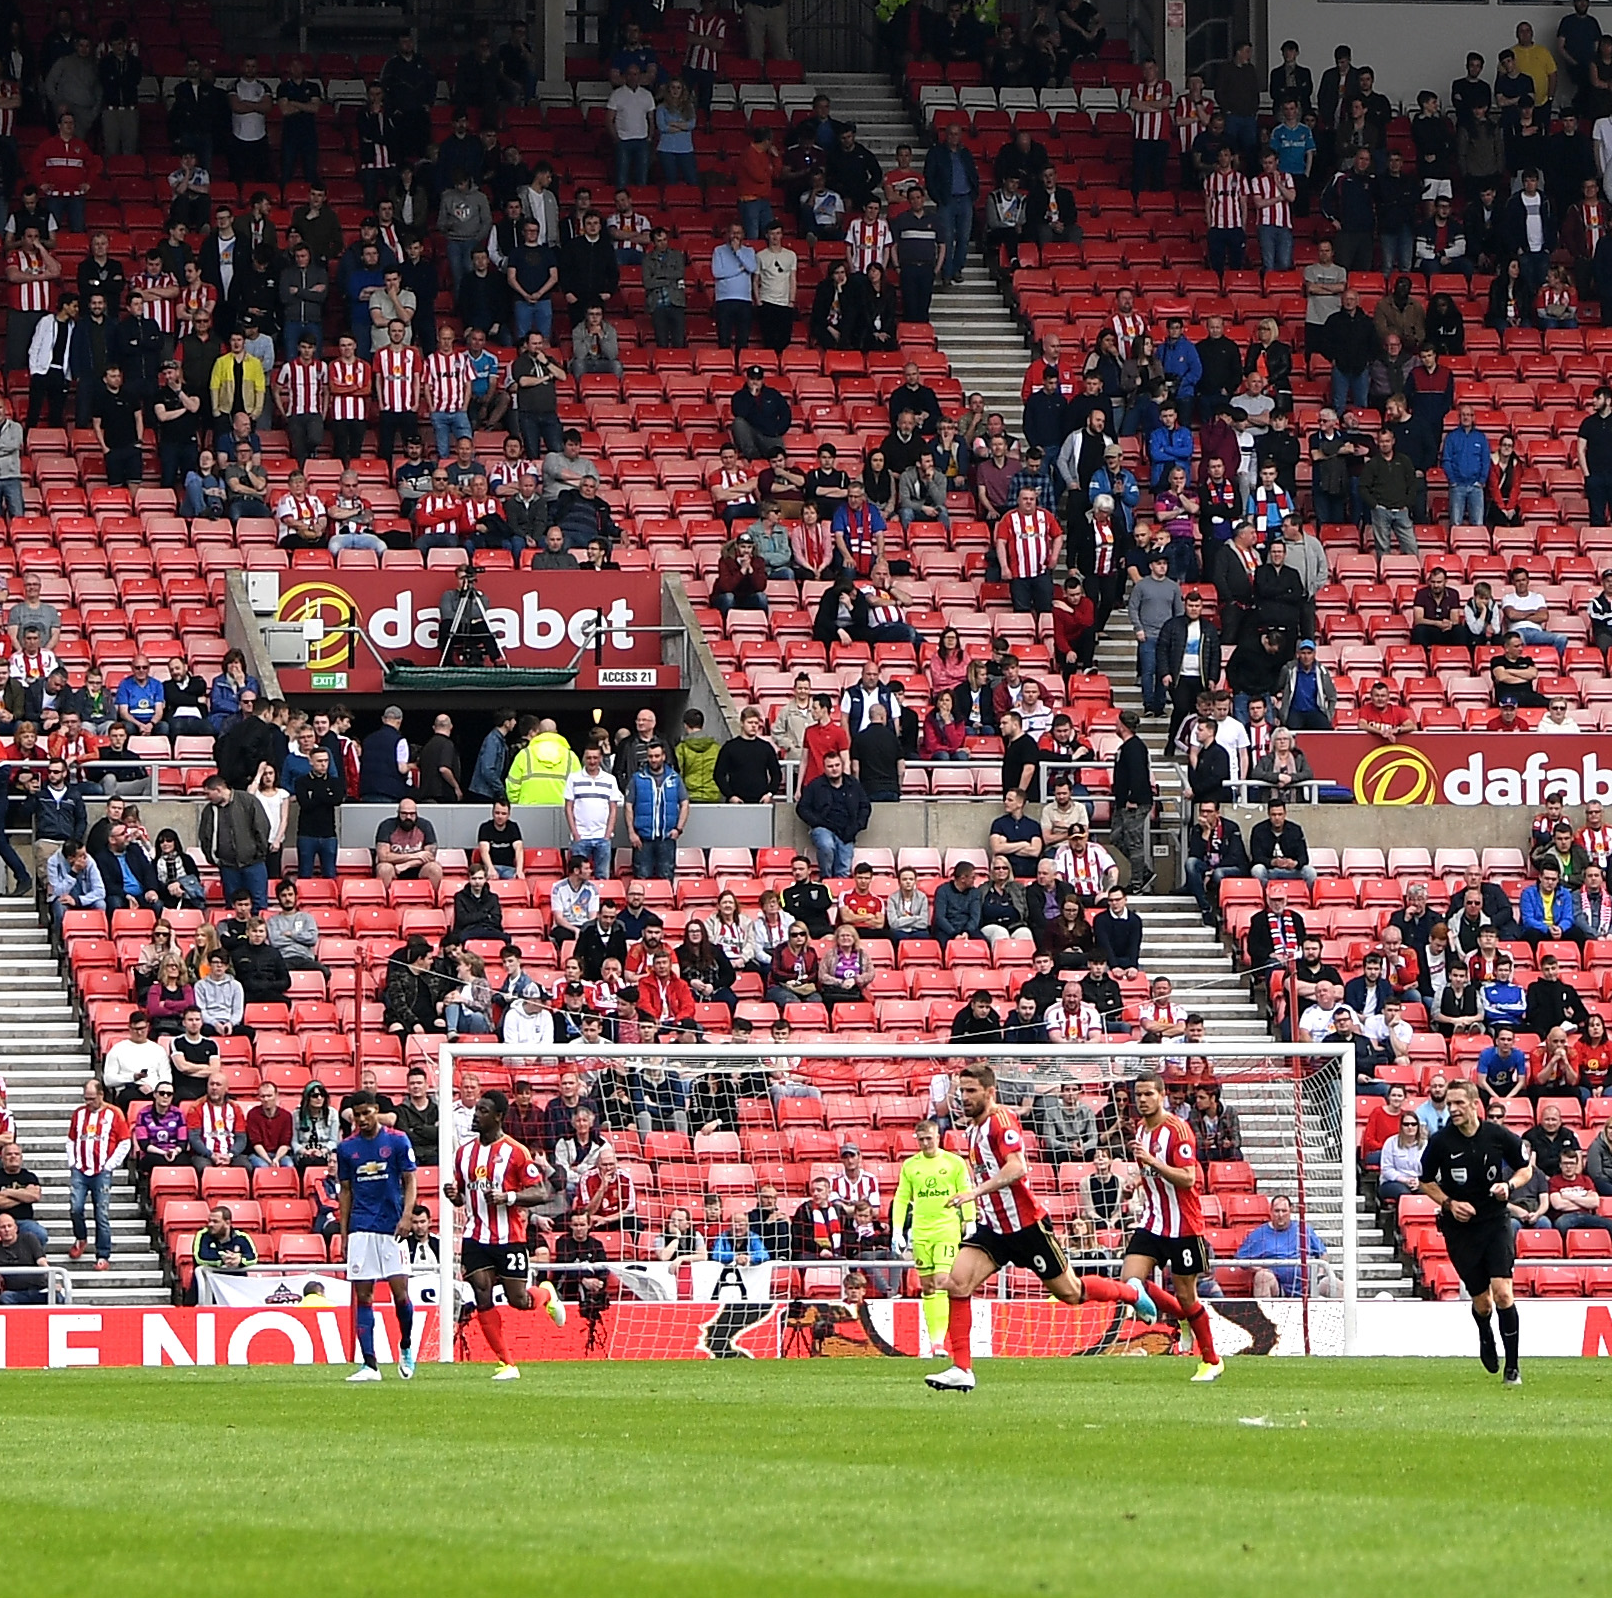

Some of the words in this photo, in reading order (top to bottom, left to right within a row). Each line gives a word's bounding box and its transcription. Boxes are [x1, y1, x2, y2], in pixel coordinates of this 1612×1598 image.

[368, 590, 634, 650] daabet
[313, 676, 334, 687] EXIT
[602, 672, 637, 684] ACCESS
[641, 672, 652, 683] 21
[917, 1188, 950, 1198] dafabet
[943, 1244, 955, 1258] 13
[1182, 1248, 1193, 1267] 8
[506, 1253, 526, 1271] 23
[1033, 1254, 1047, 1272] 9
[142, 1310, 428, 1367] NOW
